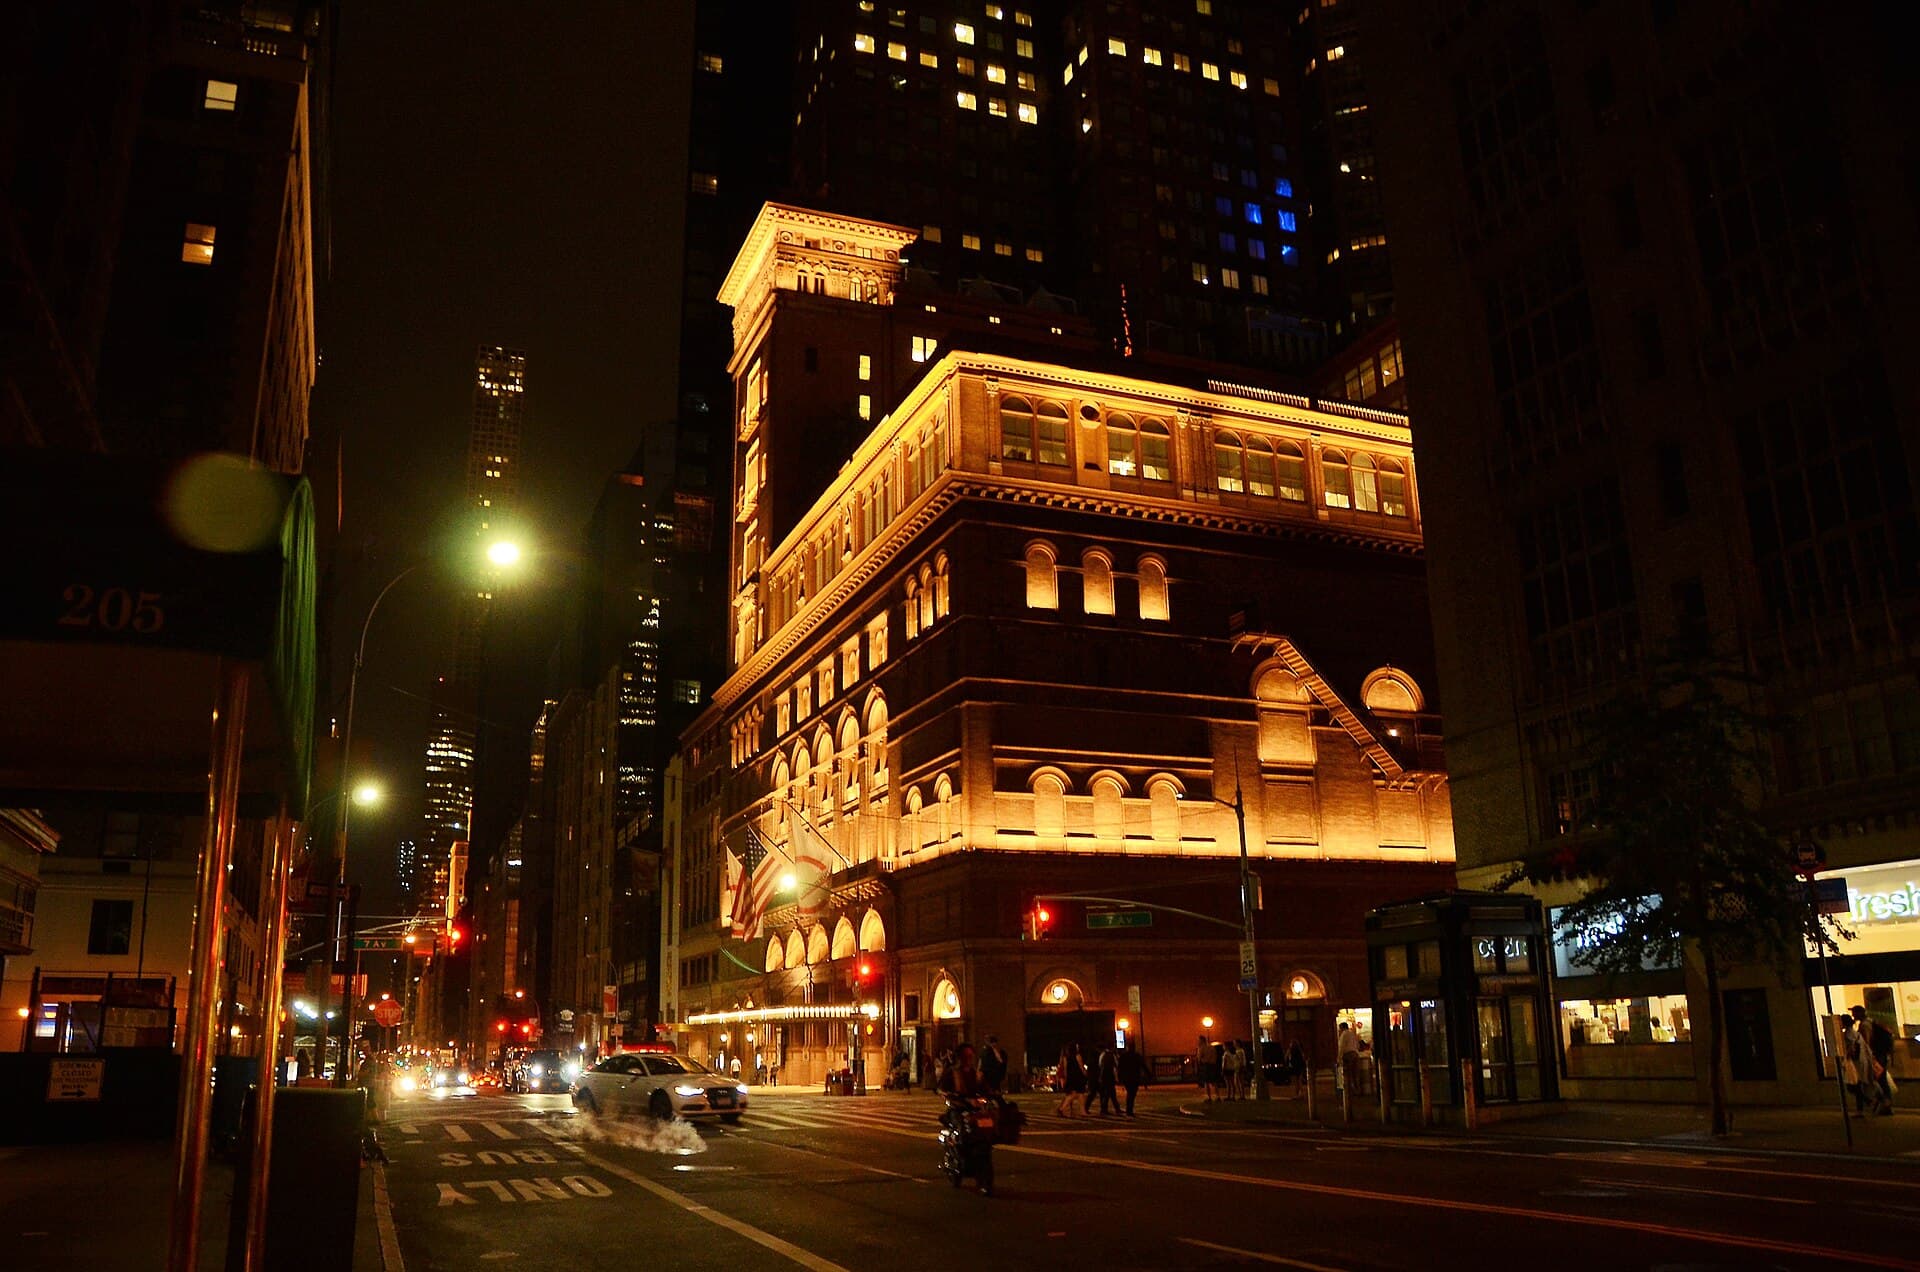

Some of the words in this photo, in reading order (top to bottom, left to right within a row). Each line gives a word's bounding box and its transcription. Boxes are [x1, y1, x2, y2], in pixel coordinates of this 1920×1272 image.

[57, 584, 165, 633] 205
[1847, 881, 1920, 922] fresh
[1242, 960, 1255, 973] 25
[377, 1008, 400, 1018] STOP
[437, 1150, 558, 1167] BUS
[436, 1175, 613, 1207] ONLY
